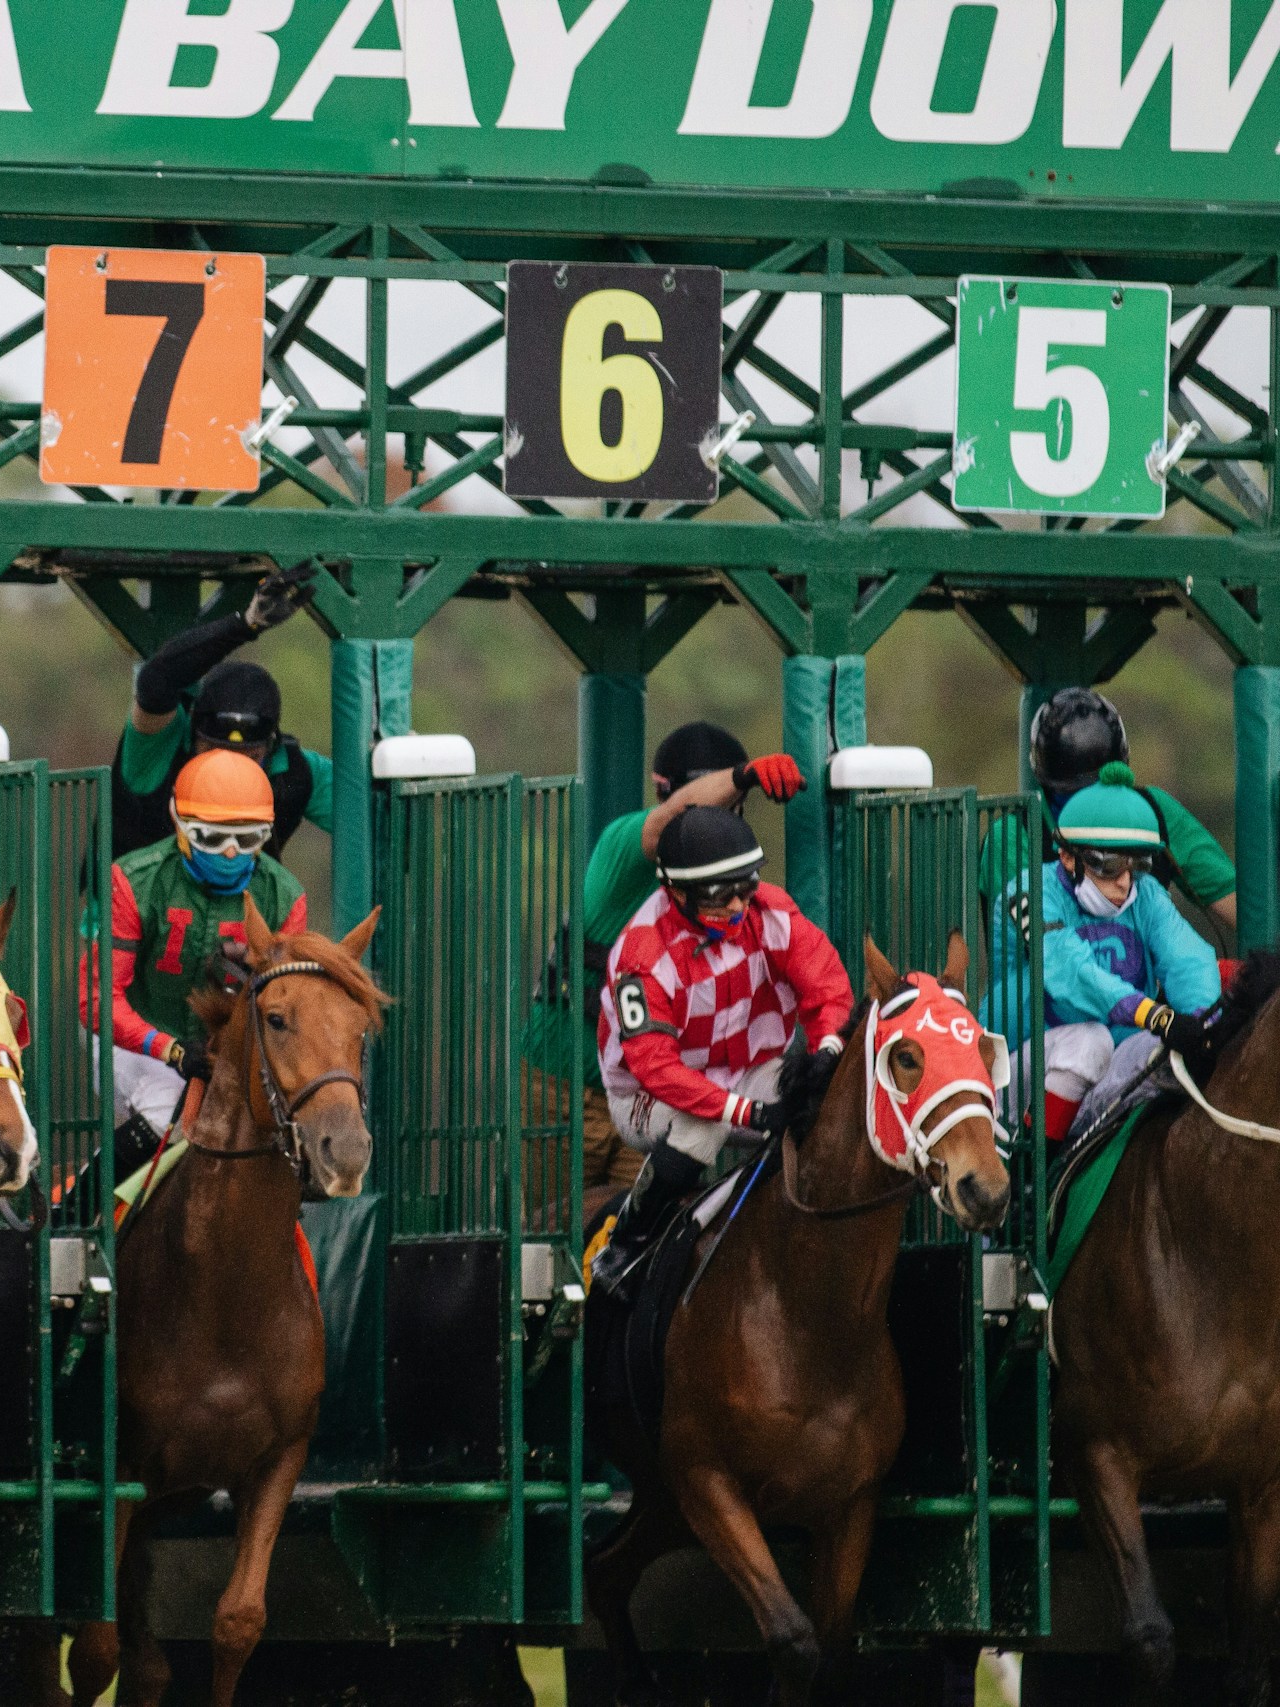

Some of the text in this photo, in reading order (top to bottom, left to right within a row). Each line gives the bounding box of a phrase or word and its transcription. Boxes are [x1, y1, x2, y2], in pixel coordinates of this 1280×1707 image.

[95, 0, 629, 131] BAY
[677, 0, 1280, 155] DOW
[104, 280, 206, 465] 7
[561, 289, 665, 483] 6
[1009, 306, 1110, 498] 5
[620, 985, 645, 1029] 6
